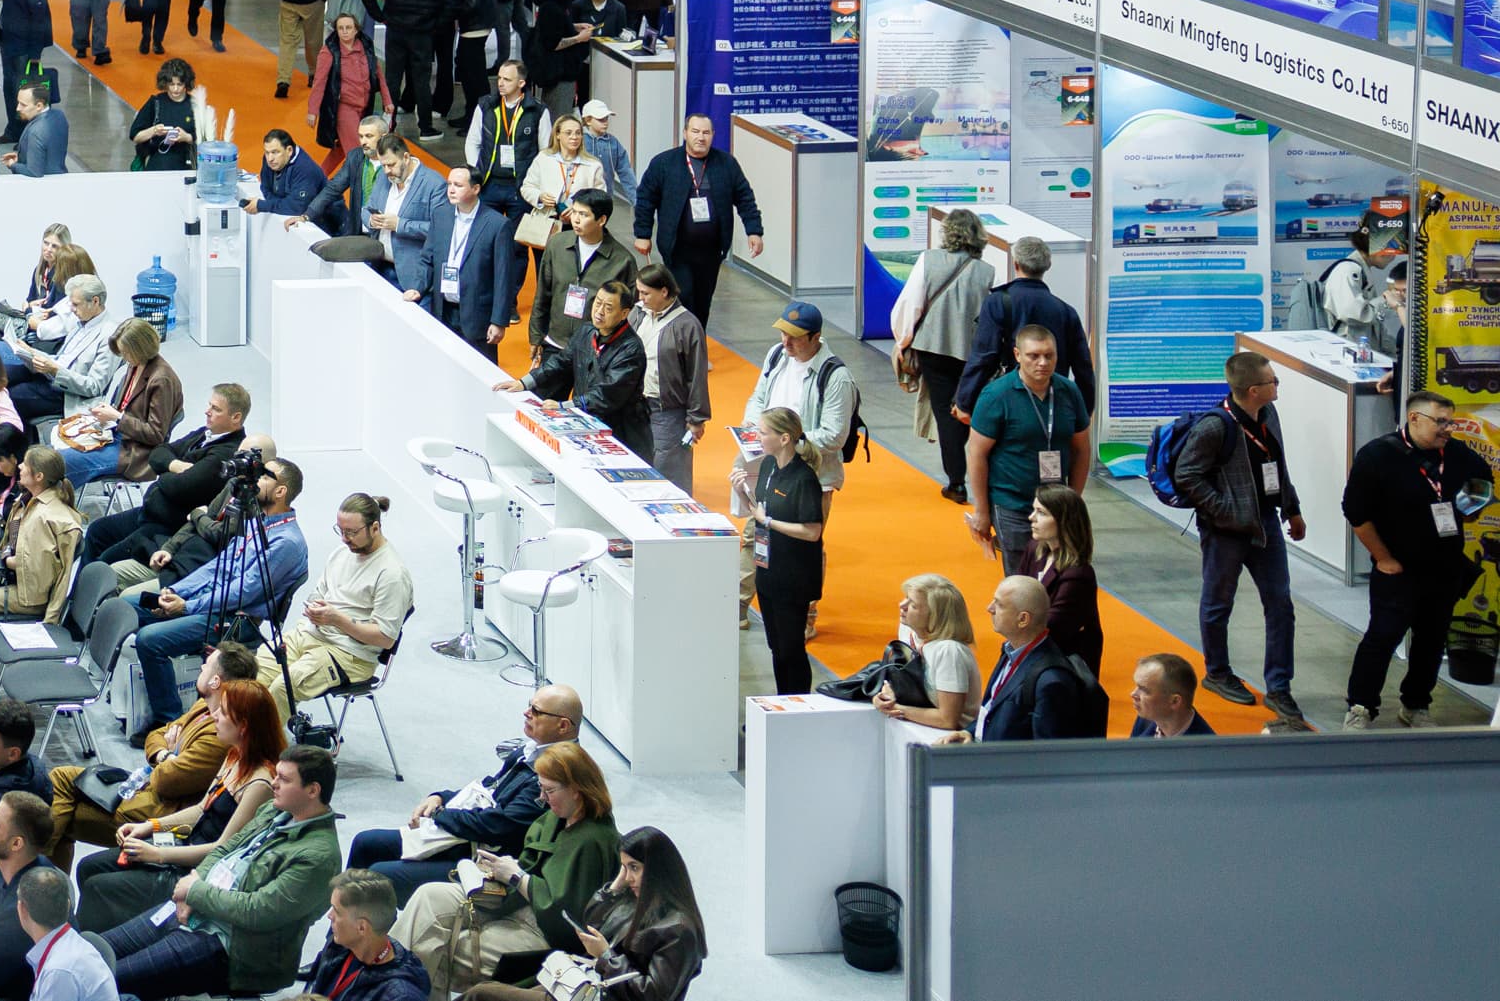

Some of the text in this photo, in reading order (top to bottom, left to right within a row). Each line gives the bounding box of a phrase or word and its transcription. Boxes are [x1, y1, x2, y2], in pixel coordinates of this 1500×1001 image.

[1121, 0, 1389, 105] Shaanxi Mingfeng Logistics Co.Ltd
[877, 115, 997, 126] China Railway Materials
[1381, 115, 1409, 134] 6-650
[1286, 149, 1303, 157] ООО
[1124, 154, 1141, 162] ООО
[1449, 214, 1492, 222] ASPHALT
[1378, 220, 1403, 228] 6-650
